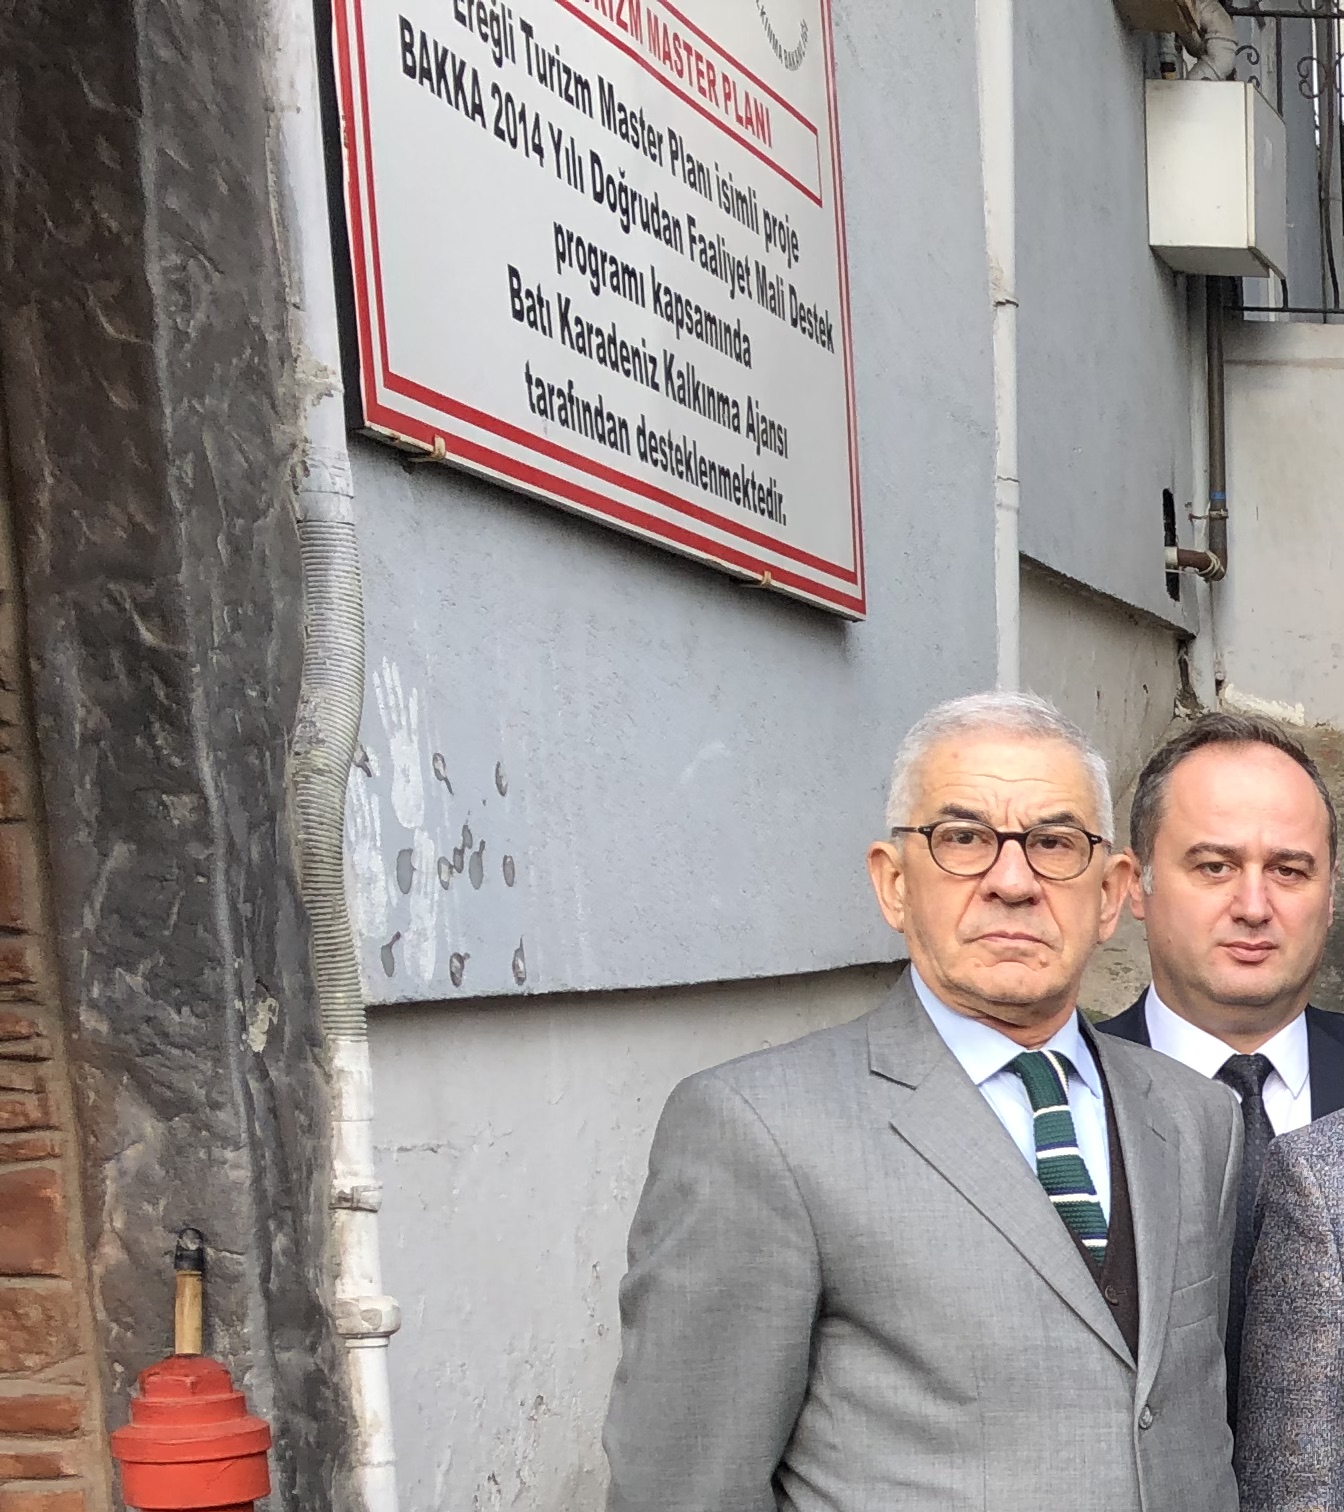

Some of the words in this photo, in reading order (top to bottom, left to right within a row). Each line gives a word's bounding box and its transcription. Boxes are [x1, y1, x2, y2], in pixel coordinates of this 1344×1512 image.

[519, 17, 593, 119] Turizm
[598, 74, 663, 167] Master
[667, 126, 713, 202] Planı
[714, 161, 759, 235] isimli
[763, 207, 799, 269] proje
[647, 8, 719, 108] MASTER
[721, 71, 772, 149] PLANI
[398, 14, 486, 129] BAKKA
[491, 82, 544, 167] 2014
[548, 121, 585, 194] Yılı
[589, 149, 684, 255] Doğrudan
[686, 213, 752, 300] Faaliyet
[754, 260, 786, 321] Mali
[788, 283, 835, 354] Destek
[507, 263, 553, 339] Batı
[557, 292, 660, 392] Karadeniz
[663, 348, 741, 434] Kalkınma
[746, 395, 788, 459] Ajansı
[553, 220, 646, 308] programı
[650, 264, 752, 369] kapsamında
[525, 359, 631, 456] tarafından
[637, 413, 787, 526] desteklenmektedir.
